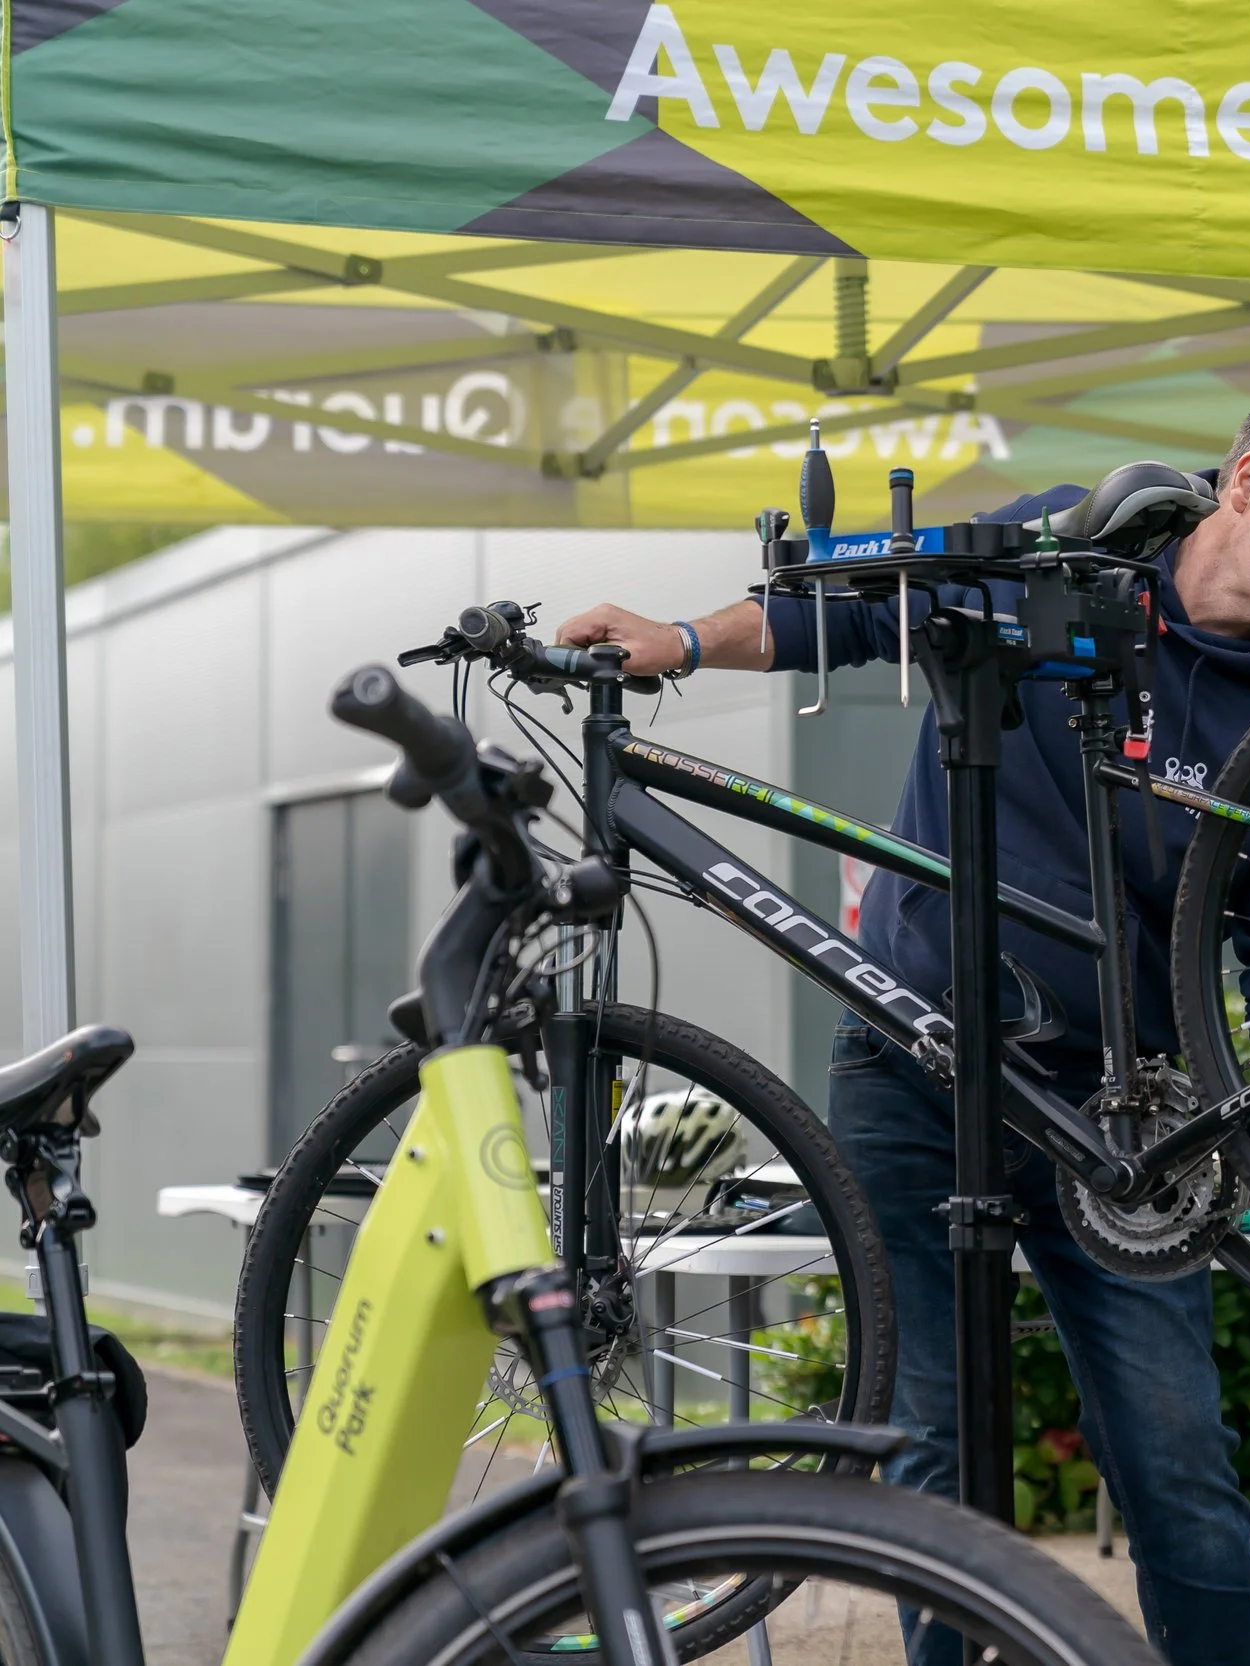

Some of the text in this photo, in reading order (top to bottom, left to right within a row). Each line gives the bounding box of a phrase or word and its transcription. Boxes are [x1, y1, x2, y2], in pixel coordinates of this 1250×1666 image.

[832, 536, 925, 559] Park Tl
[317, 1297, 373, 1436] Quorum
[335, 1382, 376, 1457] Park
